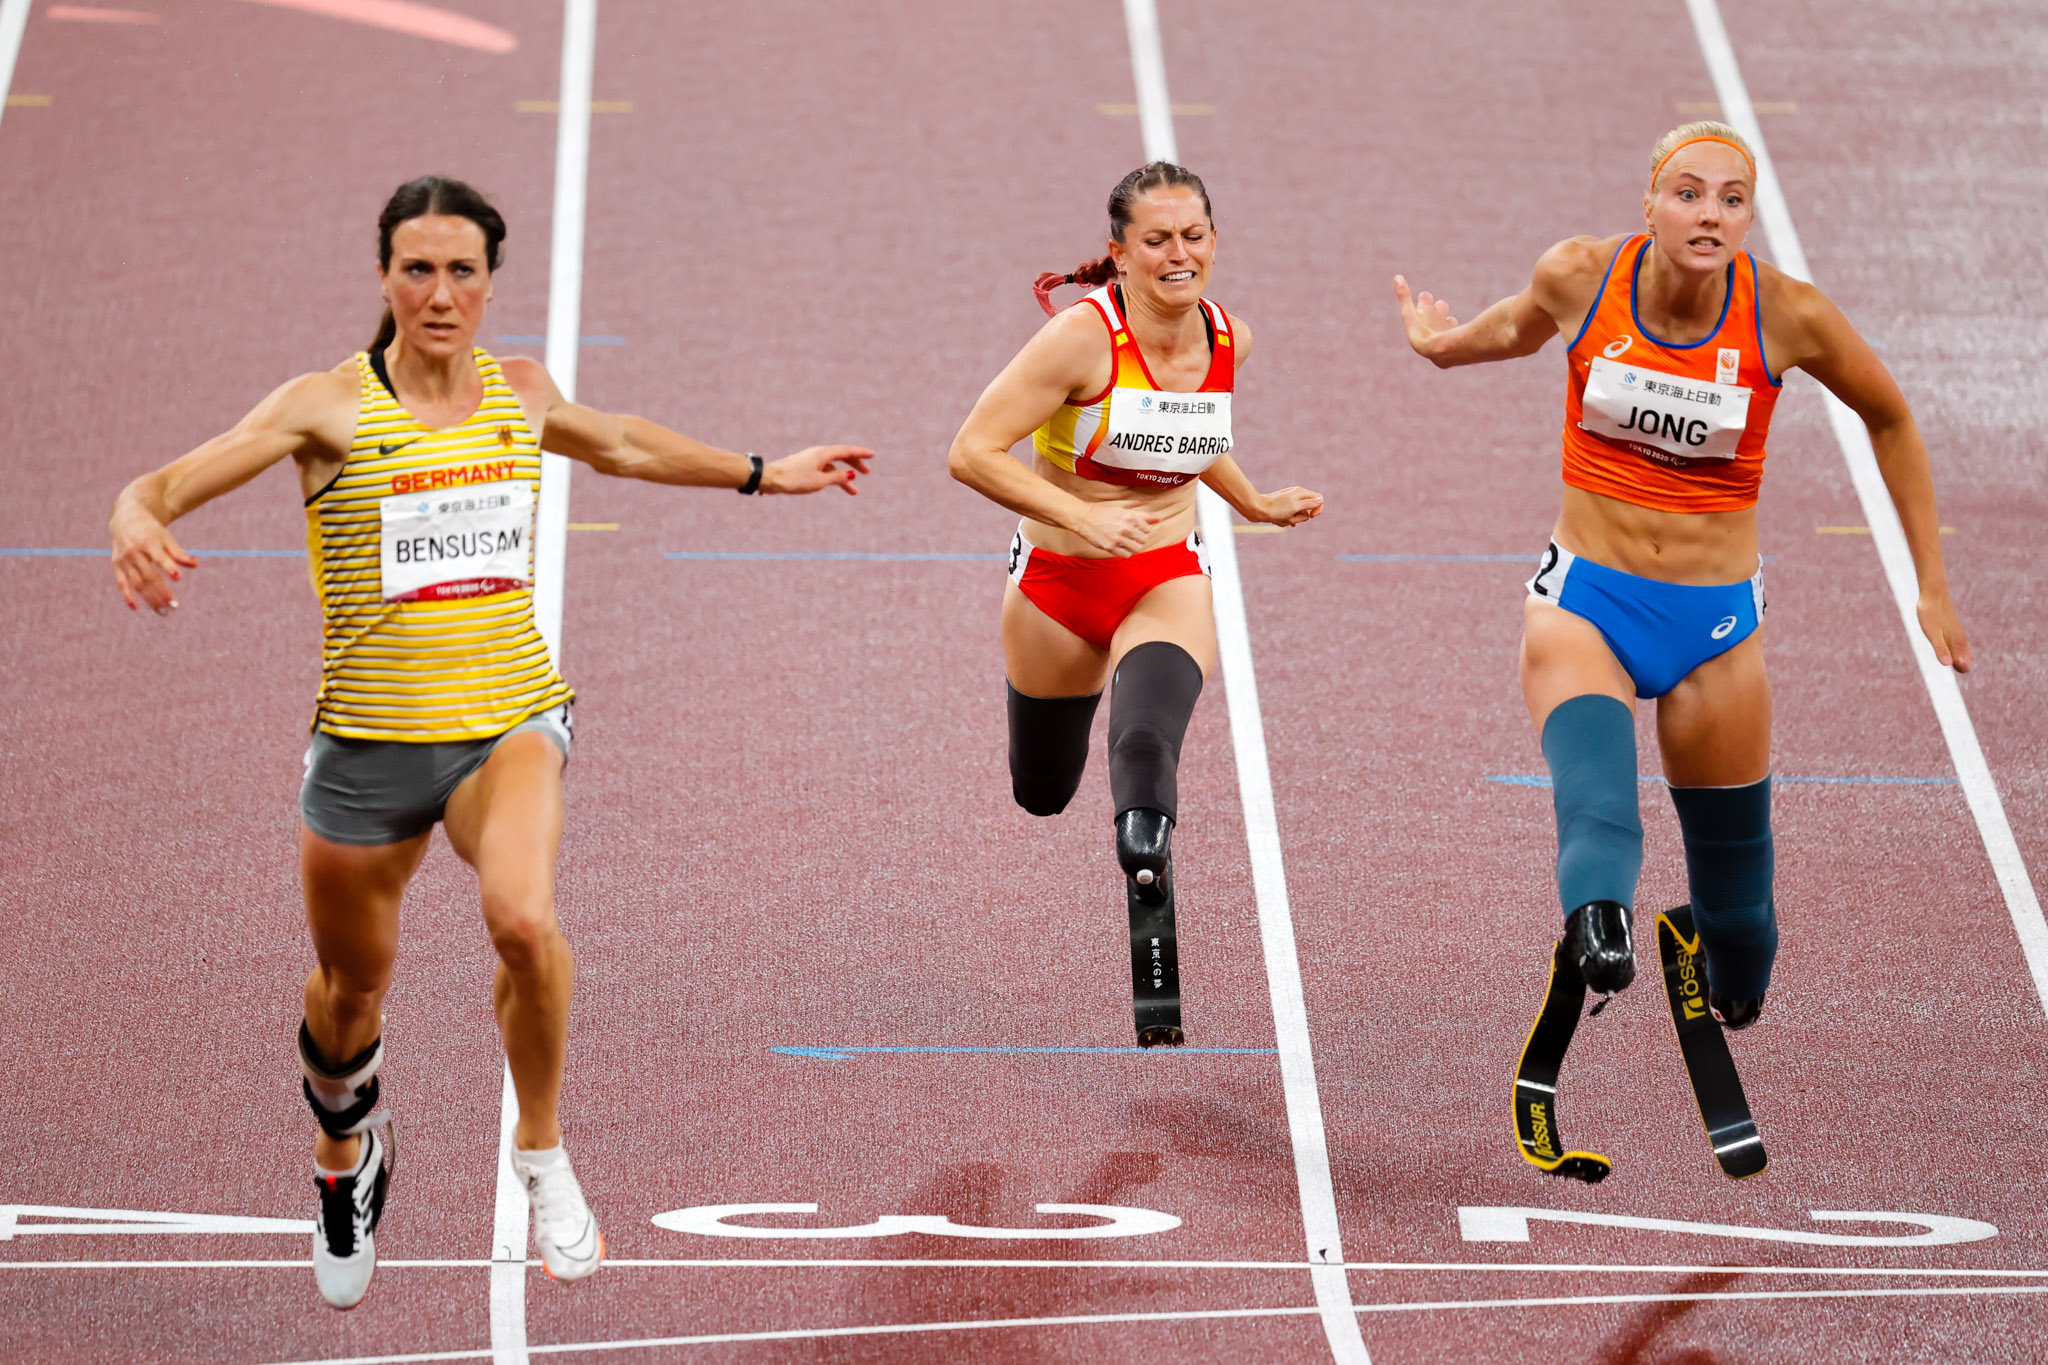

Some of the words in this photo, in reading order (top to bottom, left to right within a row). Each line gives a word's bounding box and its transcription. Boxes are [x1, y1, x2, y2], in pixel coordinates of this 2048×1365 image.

[1158, 401, 1216, 414] 東京海上日動
[1643, 379, 1722, 407] 東京海上日動
[1618, 406, 1708, 446] JONG
[1109, 432, 1174, 454] ANDRES
[1629, 443, 1652, 456] TOKYO
[1651, 450, 1669, 461] 2020
[391, 460, 516, 494] GERMANY
[1136, 473, 1157, 482] TOKYO
[1156, 476, 1173, 484] 2020
[396, 527, 524, 563] BENSUSAN
[651, 1203, 1182, 1238] 3
[1457, 1206, 1999, 1246] 2
